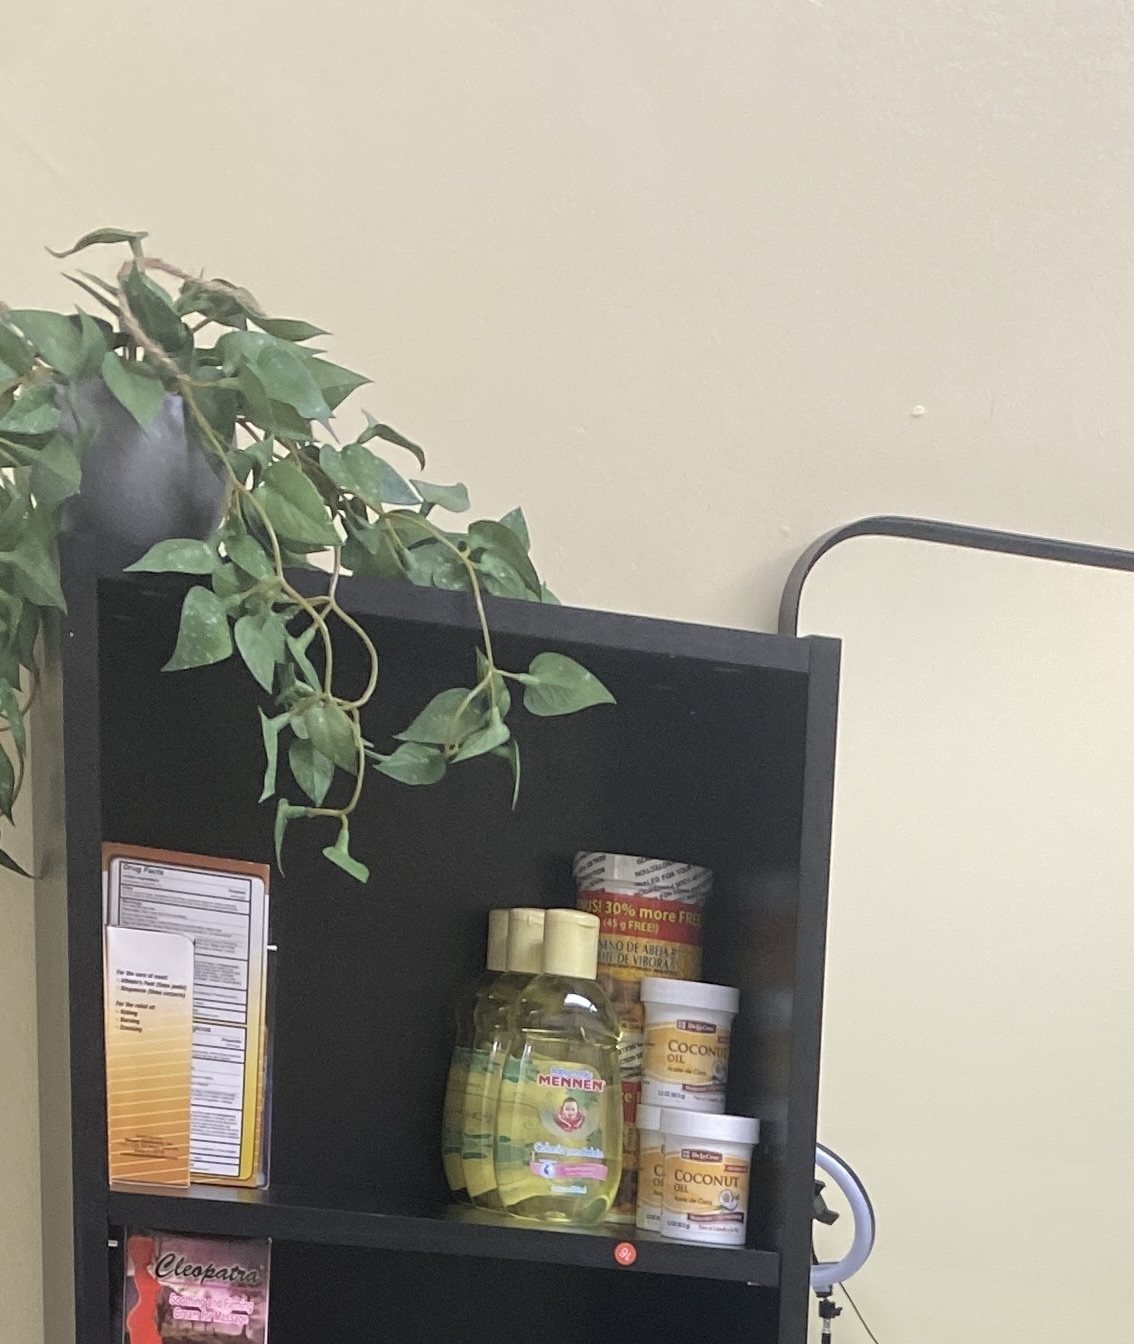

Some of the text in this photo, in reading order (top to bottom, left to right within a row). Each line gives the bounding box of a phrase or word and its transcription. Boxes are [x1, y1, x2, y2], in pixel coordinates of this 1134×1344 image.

[605, 901, 636, 917] 30%
[639, 907, 677, 923] more
[620, 922, 626, 931] g
[627, 940, 669, 958] DE ABEJA
[617, 953, 629, 964] DE
[666, 1053, 685, 1065] OIL
[538, 1075, 604, 1091] MENNEN
[674, 1169, 740, 1188] COCONUT
[673, 1183, 690, 1194] OIL
[154, 1253, 259, 1285] Cleopatra
